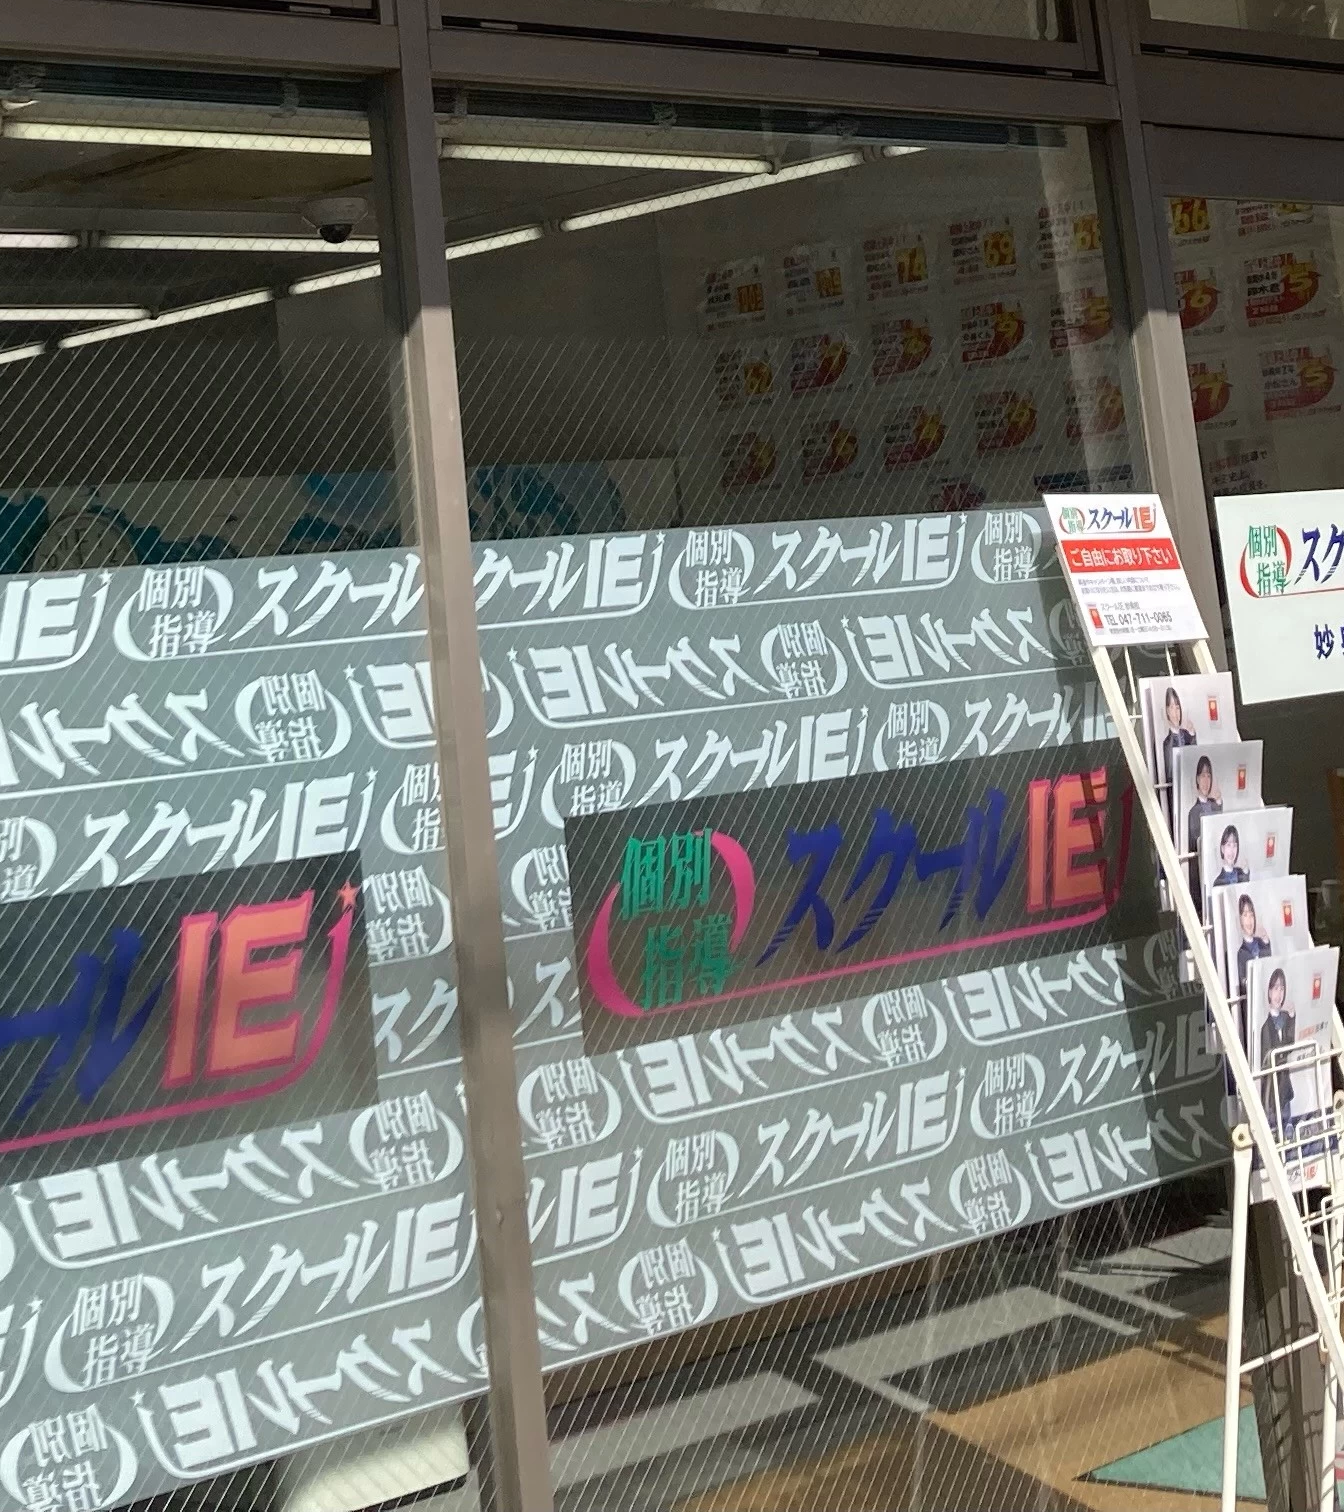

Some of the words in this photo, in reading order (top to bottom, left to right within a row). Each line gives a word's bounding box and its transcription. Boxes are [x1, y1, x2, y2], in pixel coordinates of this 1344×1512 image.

[686, 529, 734, 569] 個別
[984, 512, 1026, 547] 個別
[1247, 524, 1278, 559] 個別
[992, 544, 1043, 581] 指導
[1069, 547, 1174, 568] ご自由にお取り下さい
[1256, 560, 1290, 597] 指導
[136, 565, 206, 612] 個別
[693, 565, 752, 609] 指導
[148, 609, 230, 659] 指導
[887, 702, 932, 738] 個別
[560, 739, 614, 786] 個別
[570, 776, 636, 817] 指導
[619, 827, 714, 921] 個別
[638, 913, 742, 1010] 指導
[983, 1052, 1026, 1093] 個別
[993, 1091, 1041, 1129] 指導
[665, 1128, 718, 1177] 個別
[673, 1176, 737, 1226] 指導
[71, 1274, 144, 1338] 個別
[80, 1325, 168, 1388] 指導
